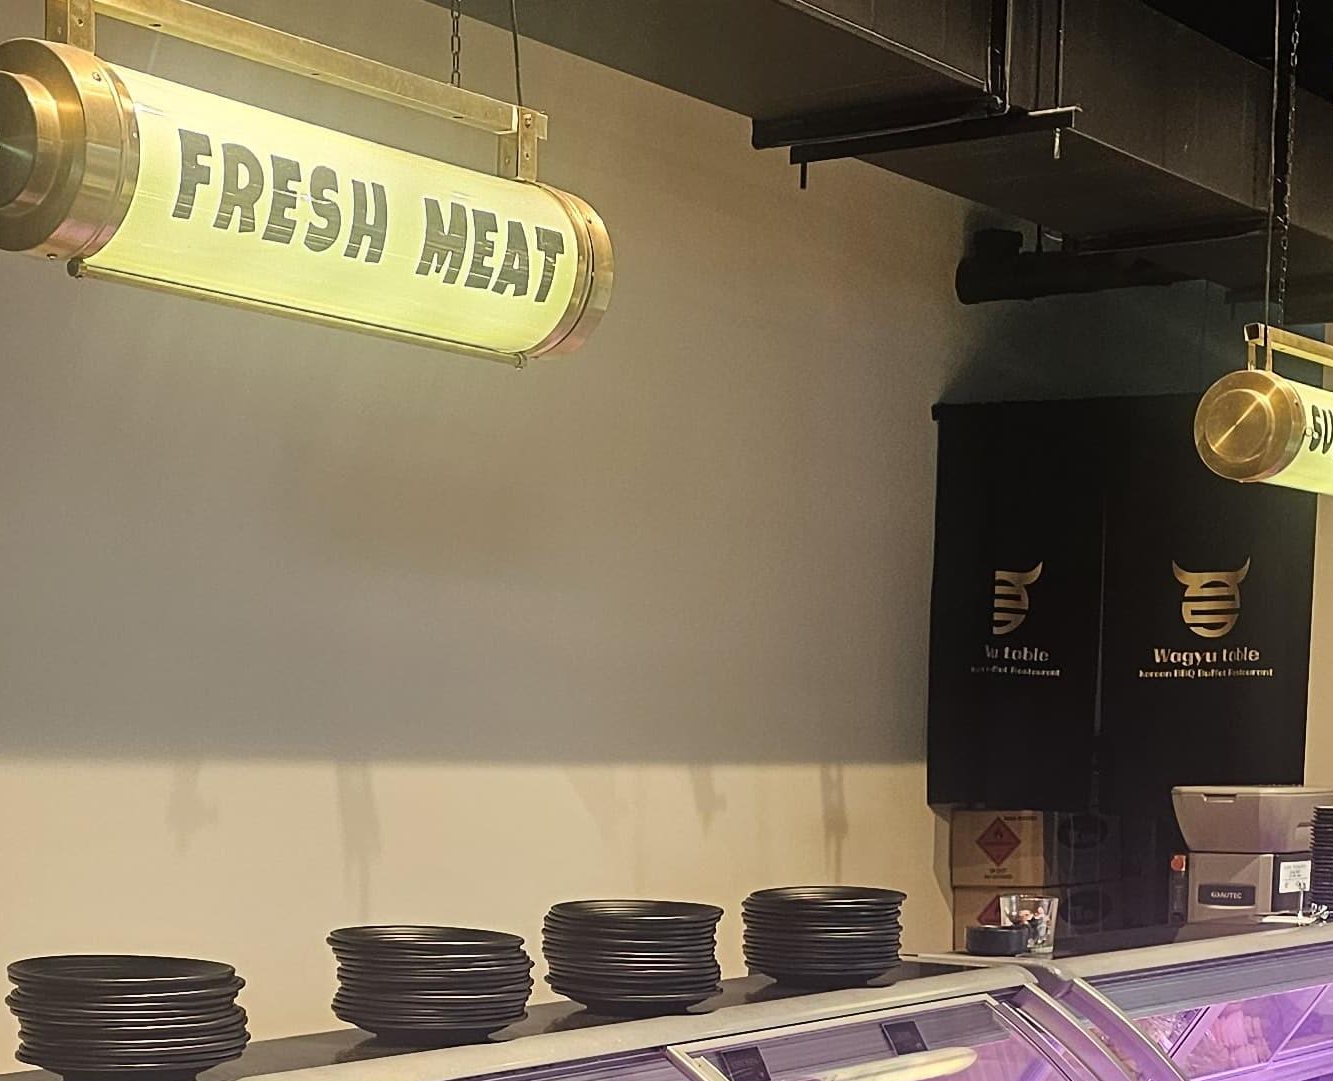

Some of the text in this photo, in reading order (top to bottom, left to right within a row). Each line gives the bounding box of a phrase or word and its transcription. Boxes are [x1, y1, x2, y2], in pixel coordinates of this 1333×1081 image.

[171, 128, 565, 303] FRESH MEAT
[1153, 646, 1260, 667] Wagyu table
